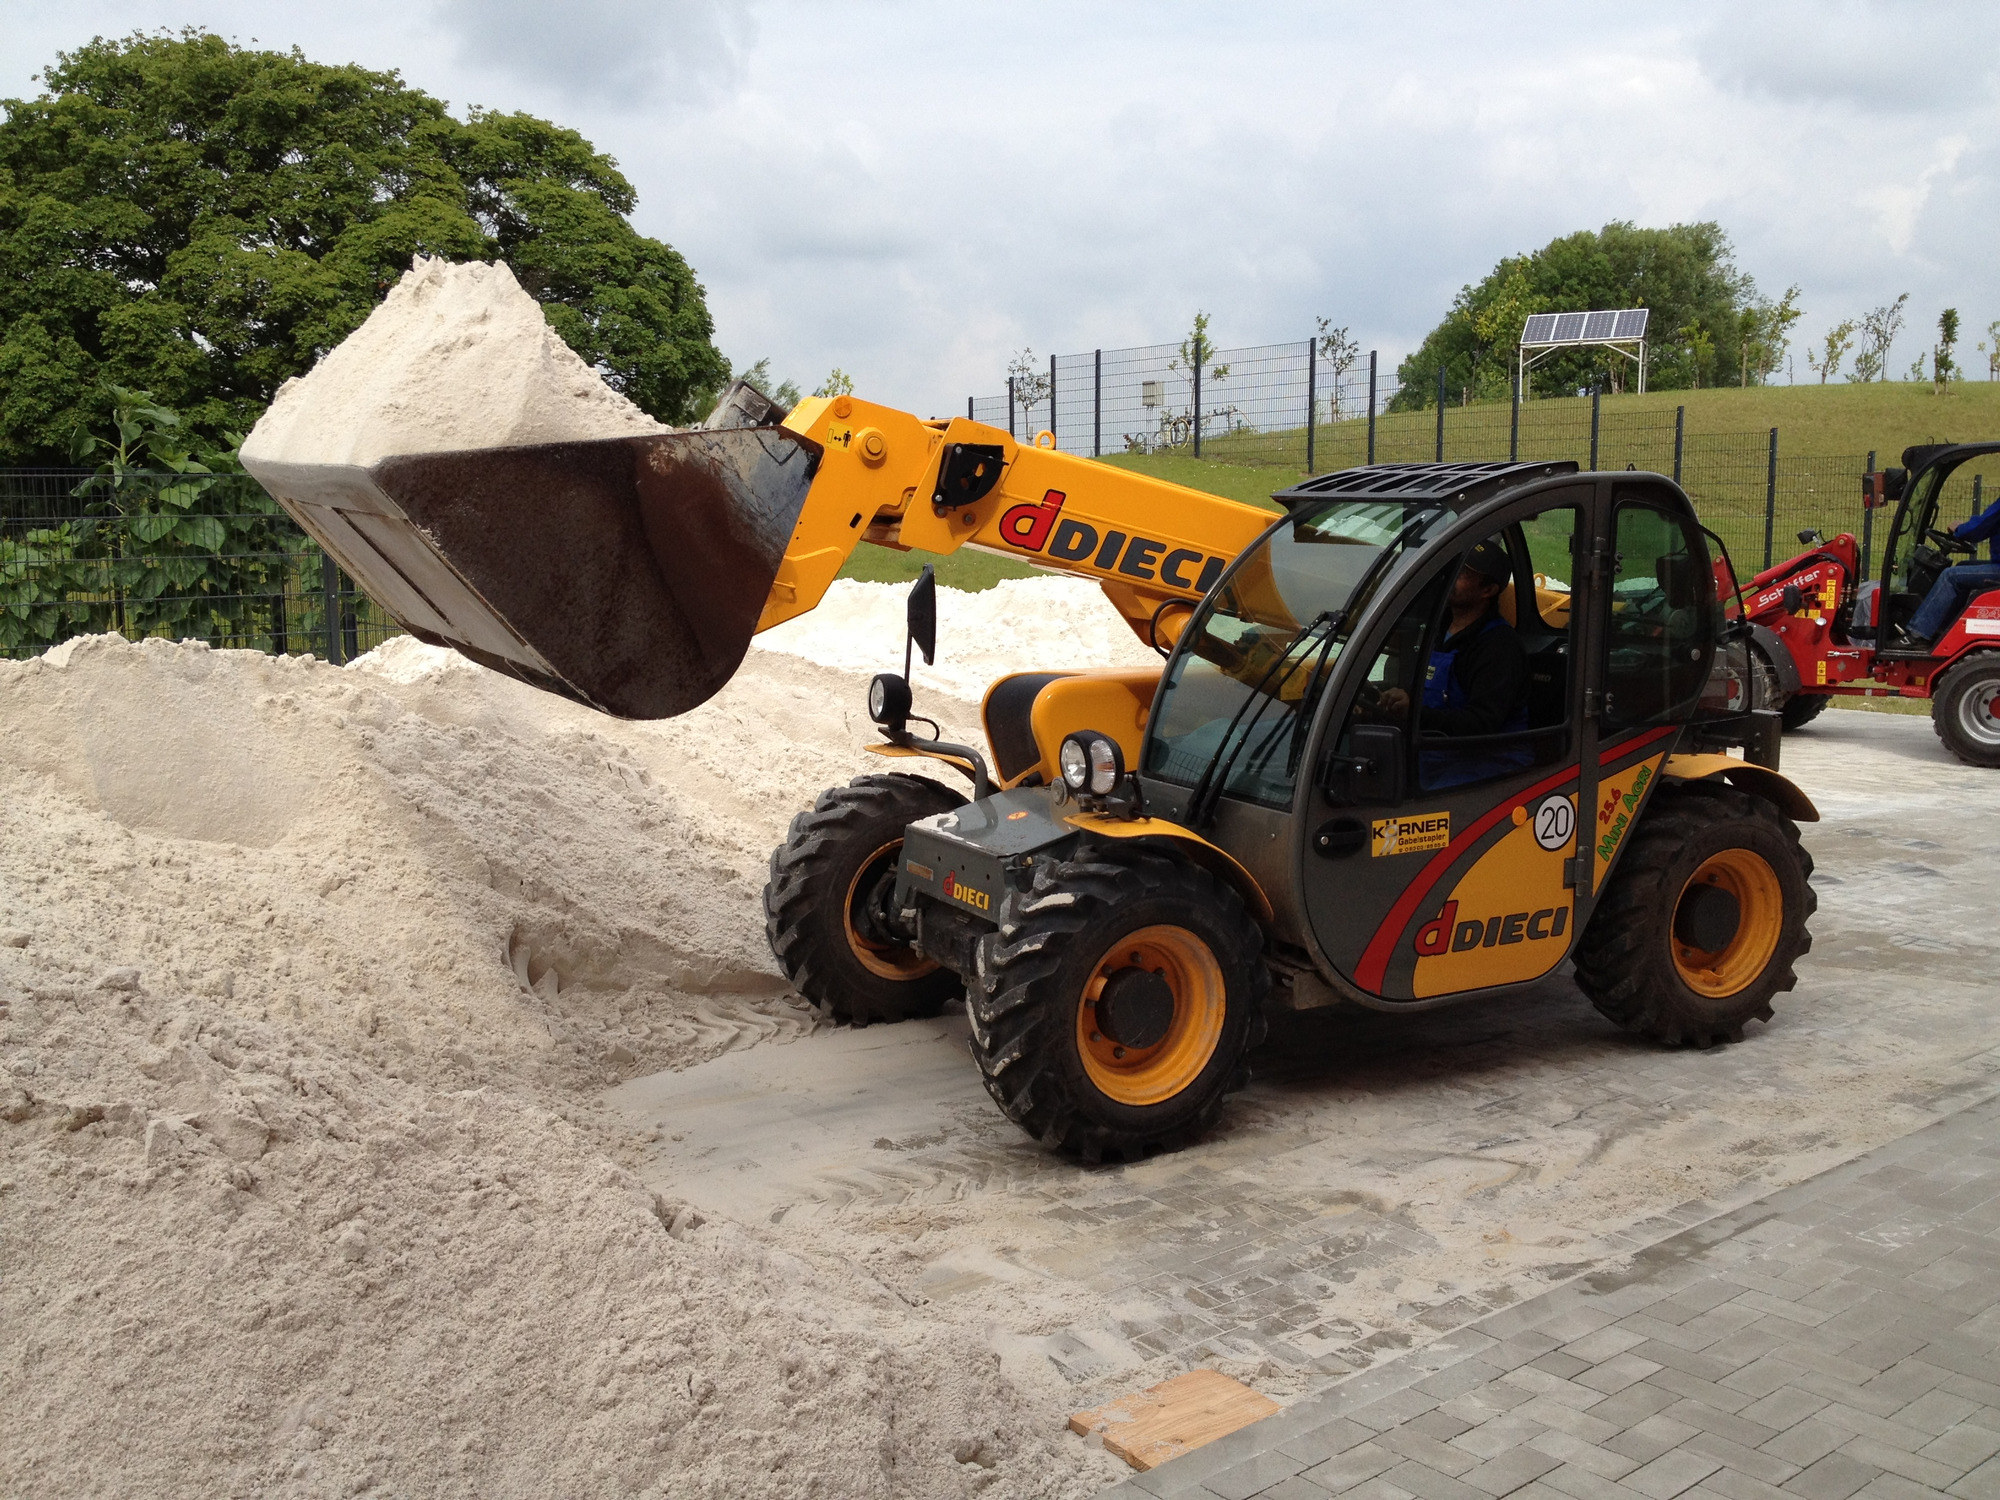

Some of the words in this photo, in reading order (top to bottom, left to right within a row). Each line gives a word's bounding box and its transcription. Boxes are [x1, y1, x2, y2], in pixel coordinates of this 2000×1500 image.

[1758, 570, 1820, 608] Schffer
[1541, 804, 1569, 840] 20
[1597, 813, 1628, 862] MINI
[1622, 765, 1653, 813] AGRI
[1599, 788, 1621, 824] 25.6
